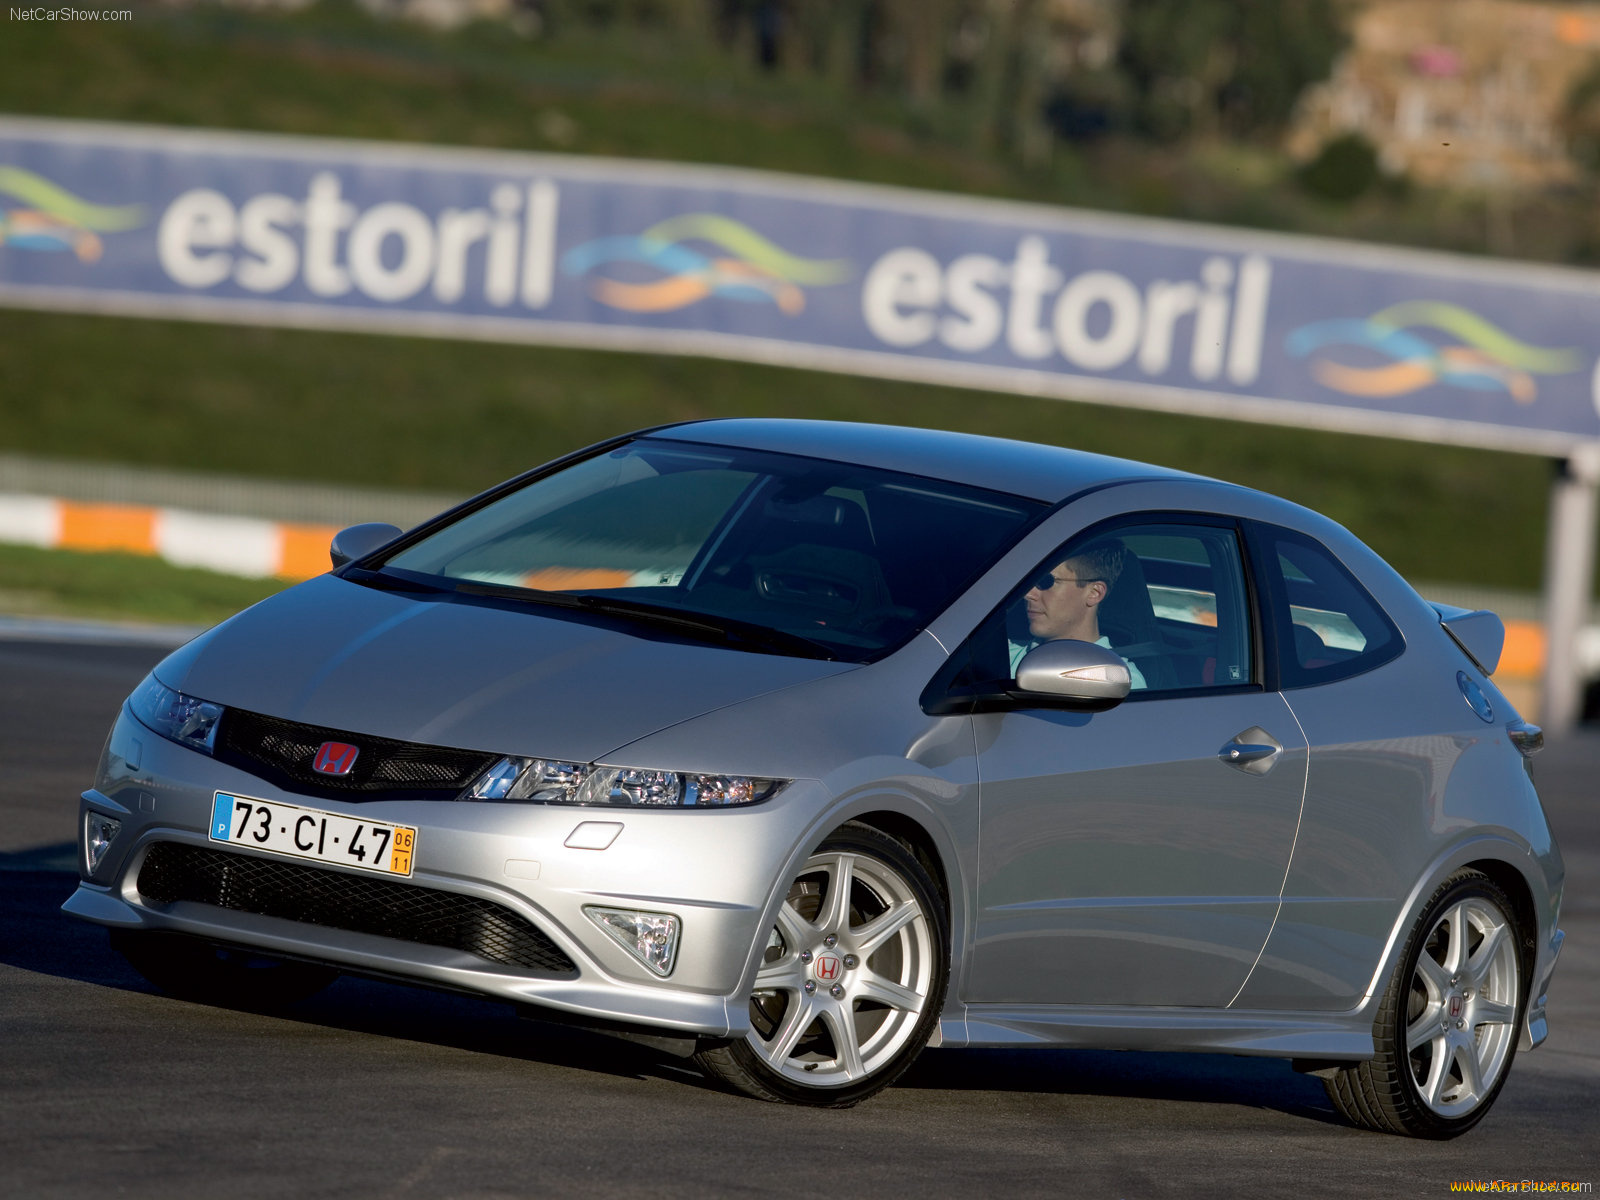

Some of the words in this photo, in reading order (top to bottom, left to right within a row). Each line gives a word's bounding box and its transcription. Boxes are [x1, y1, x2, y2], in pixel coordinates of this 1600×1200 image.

[158, 172, 559, 309] estoril
[862, 236, 1271, 386] estoril
[217, 823, 226, 834] P
[395, 832, 411, 847] 06
[393, 856, 408, 871] 11
